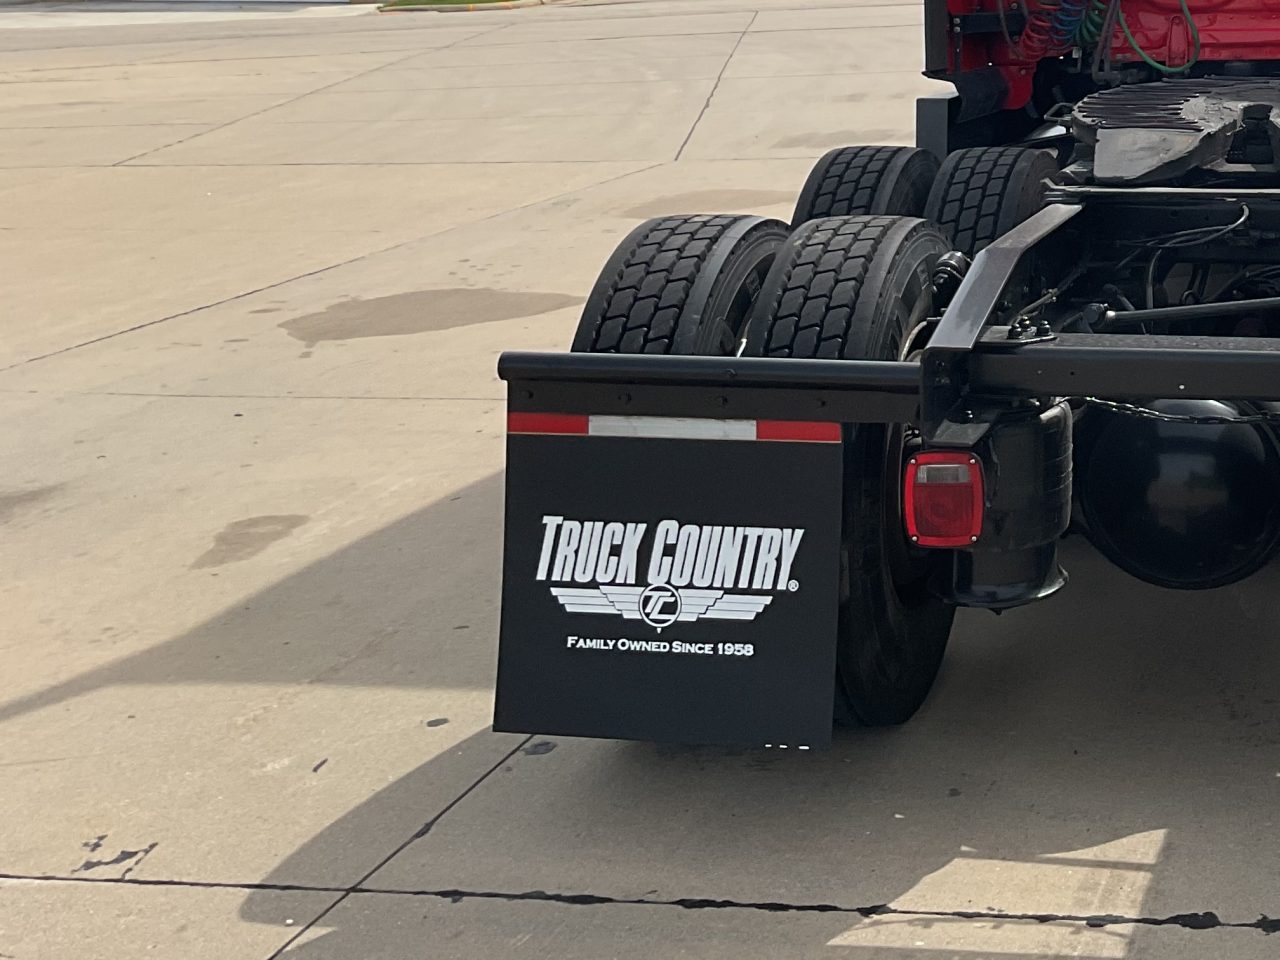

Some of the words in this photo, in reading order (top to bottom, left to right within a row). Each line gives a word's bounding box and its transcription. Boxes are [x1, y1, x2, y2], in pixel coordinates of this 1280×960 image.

[536, 515, 647, 584] TRUCK
[647, 520, 805, 591] COUNTRY
[566, 636, 616, 650] FAMILY
[617, 638, 670, 653] OWNED
[671, 640, 714, 655] SINCE
[717, 642, 754, 657] 1958
